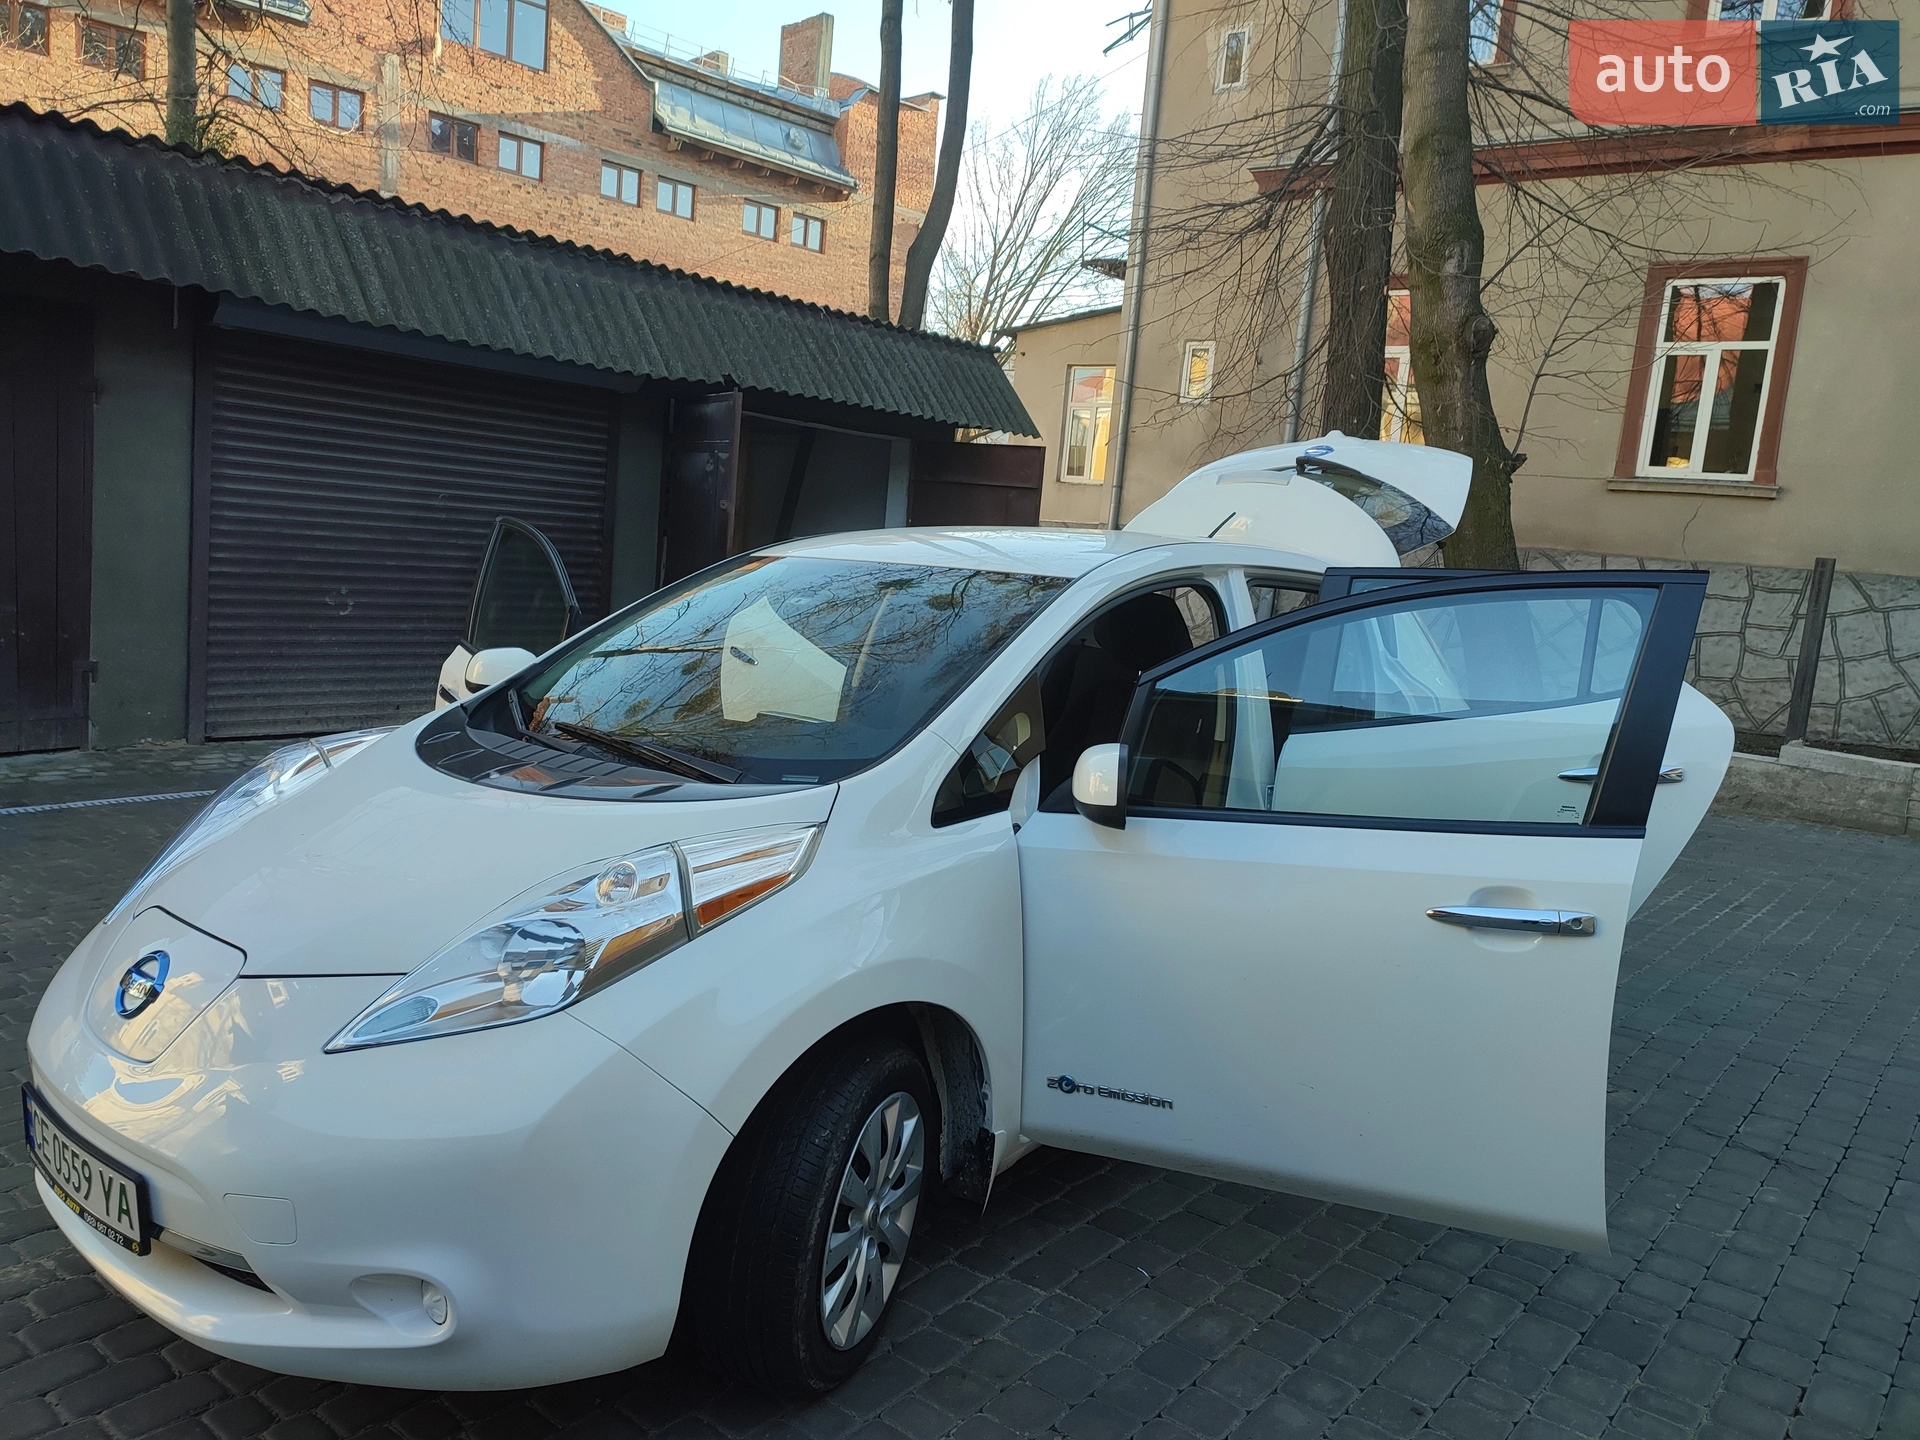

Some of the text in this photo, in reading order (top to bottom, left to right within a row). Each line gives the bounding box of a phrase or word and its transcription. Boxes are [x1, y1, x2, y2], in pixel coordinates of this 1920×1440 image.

[1098, 1085, 1173, 1110] Emission
[33, 1110, 51, 1165] CE
[53, 1133, 92, 1200] 0559
[99, 1169, 134, 1231] YA
